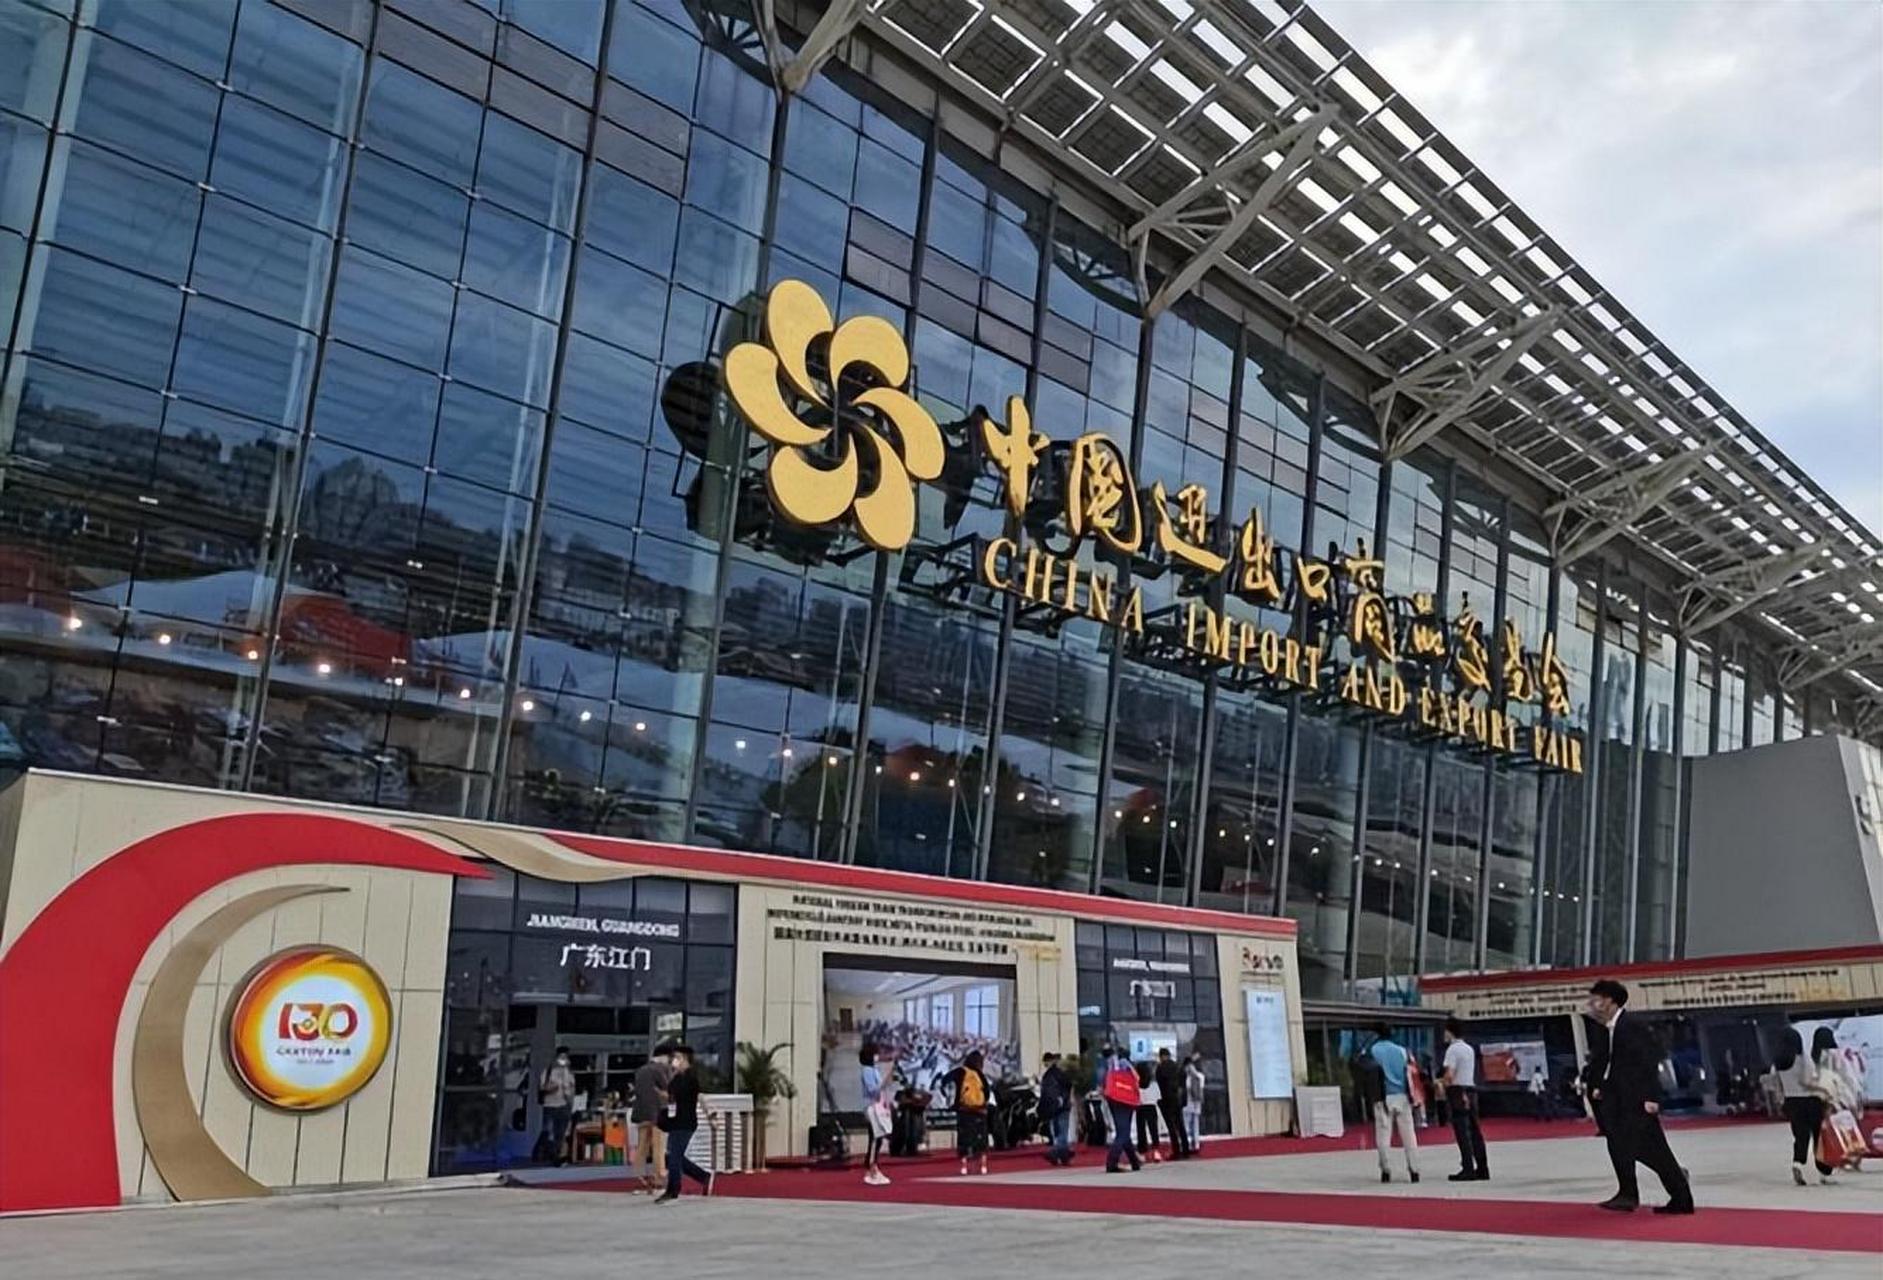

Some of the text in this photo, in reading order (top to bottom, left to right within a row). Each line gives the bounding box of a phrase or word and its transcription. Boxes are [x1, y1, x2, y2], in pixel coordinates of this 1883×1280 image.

[984, 537, 1583, 773] CHINA IMPORT AND EXPORT FAIR
[559, 942, 652, 971] 广东江门
[278, 1002, 359, 1041] 130
